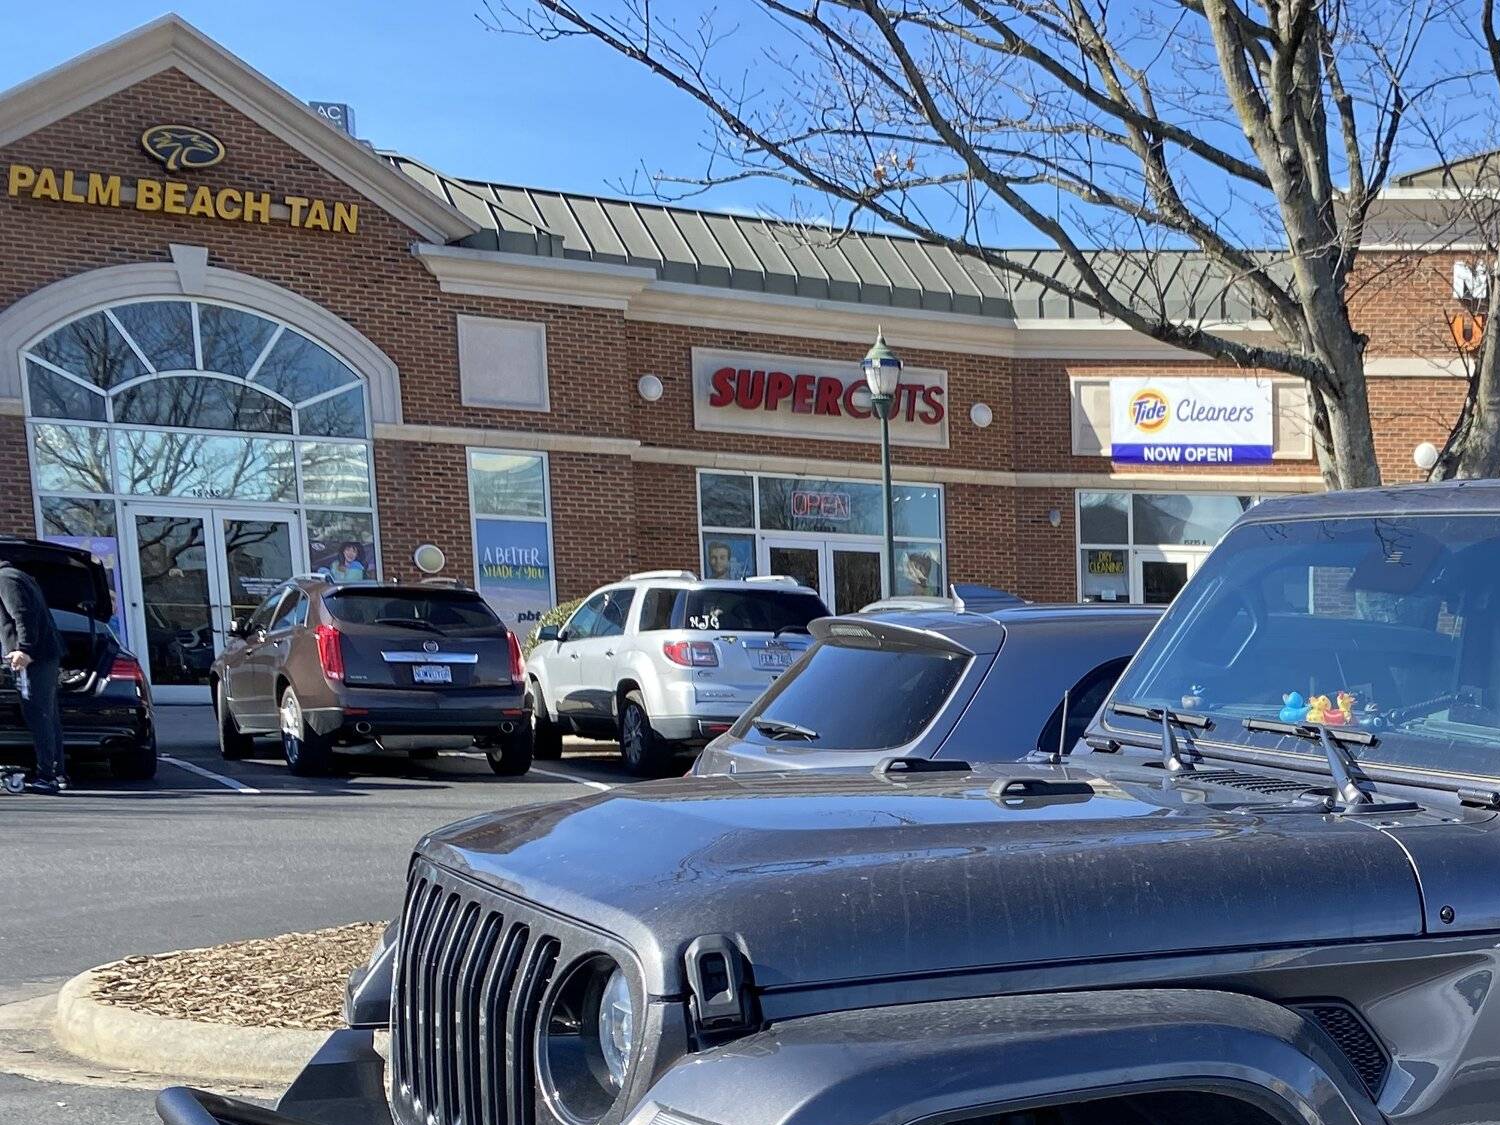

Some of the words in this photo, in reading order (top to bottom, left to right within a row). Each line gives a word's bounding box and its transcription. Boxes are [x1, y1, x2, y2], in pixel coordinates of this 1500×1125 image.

[8, 165, 121, 207] PALM
[136, 178, 270, 224] BEACH
[285, 196, 359, 234] TAN
[1133, 399, 1167, 426] Tide
[1176, 398, 1254, 422] Cleaners
[1144, 447, 1181, 462] NOW
[1185, 447, 1232, 462] OPEN!
[793, 492, 849, 516] OPEN
[484, 547, 493, 562] A
[495, 547, 543, 566] BETTER
[1098, 551, 1112, 562] DRY
[483, 564, 512, 577] SHADE
[523, 566, 545, 579] YOU
[1089, 561, 1124, 574] CLEANING
